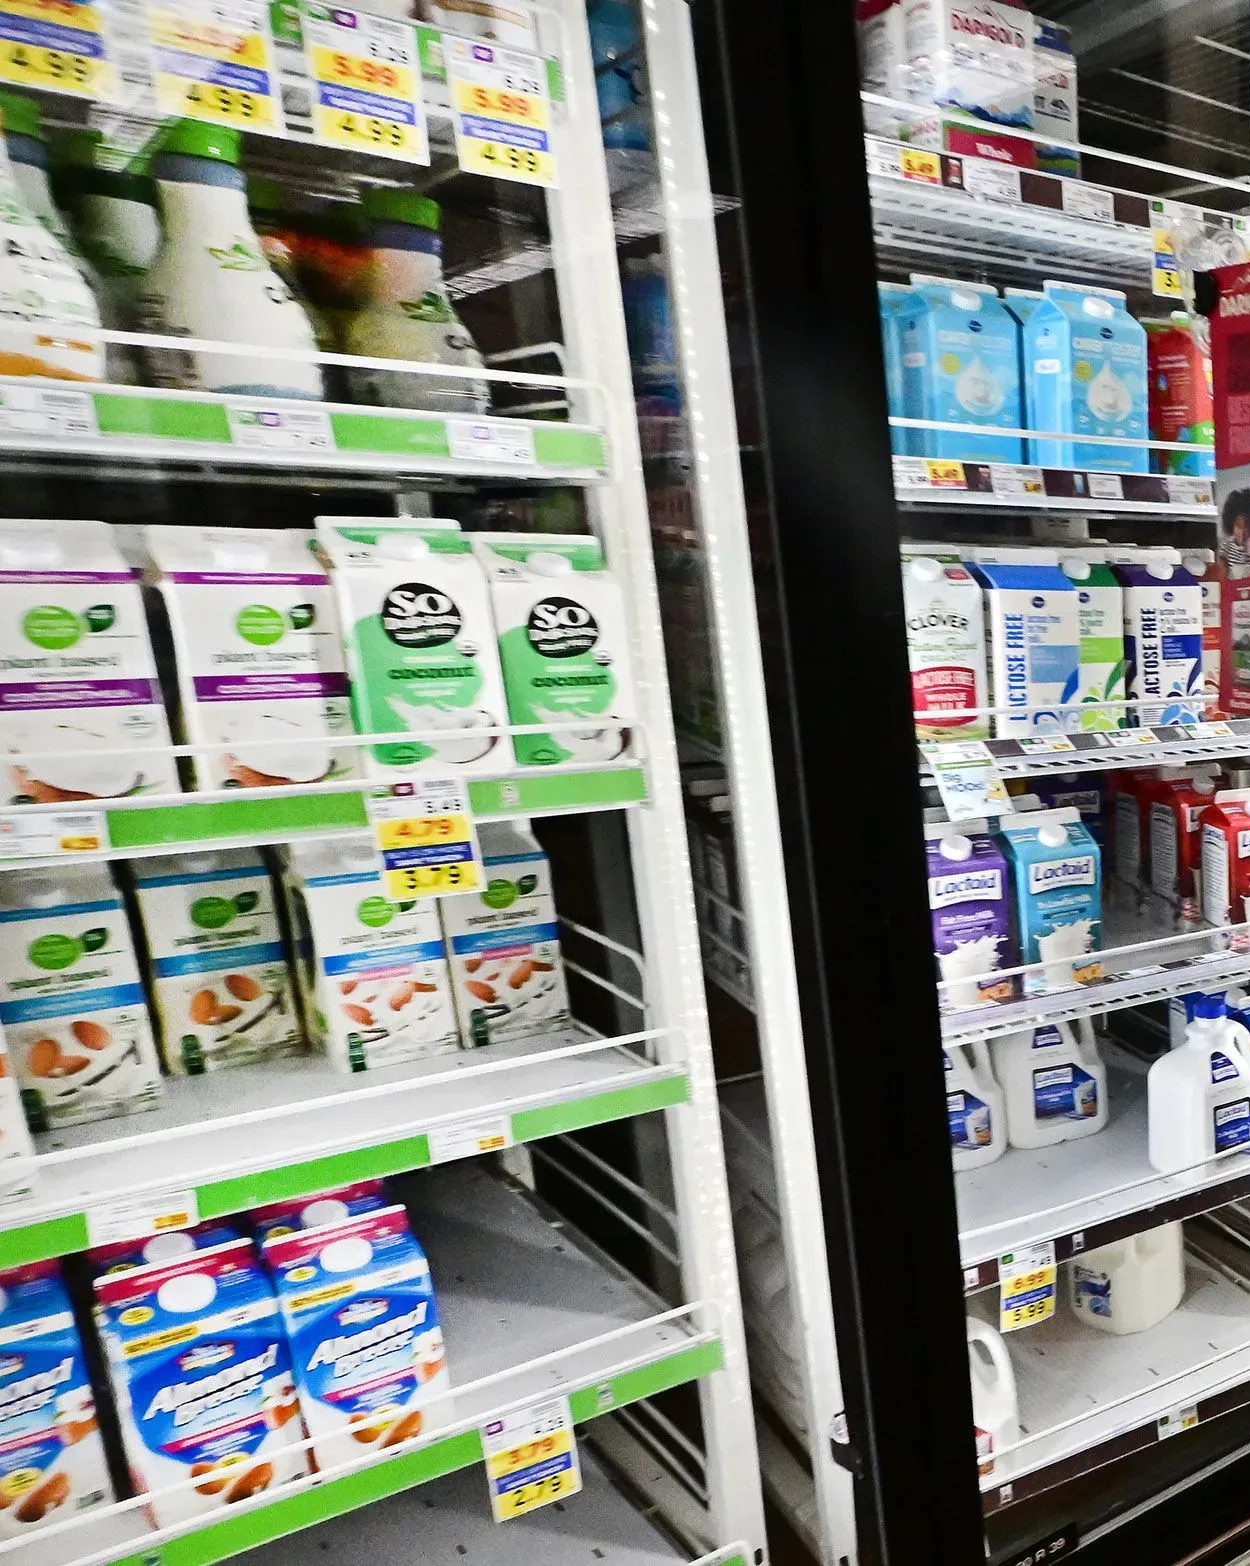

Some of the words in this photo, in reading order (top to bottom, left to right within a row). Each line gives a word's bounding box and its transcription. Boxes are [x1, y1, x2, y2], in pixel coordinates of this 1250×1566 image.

[951, 12, 1026, 49] DARIGOD
[333, 54, 398, 88] 5.99
[472, 88, 530, 116] 5.99
[480, 144, 538, 172] 4.99
[389, 590, 453, 617] SO
[533, 603, 591, 629] SO
[909, 613, 968, 631] CLOVER
[1004, 614, 1025, 649] FREE
[1140, 608, 1158, 640] FREE
[1142, 643, 1161, 698] ACTOSE
[935, 872, 997, 897] Lactaid
[1035, 859, 1091, 882] Lactaid
[1014, 1271, 1045, 1290] 6.99
[306, 1301, 429, 1372] Almond
[142, 1343, 279, 1421] Almond
